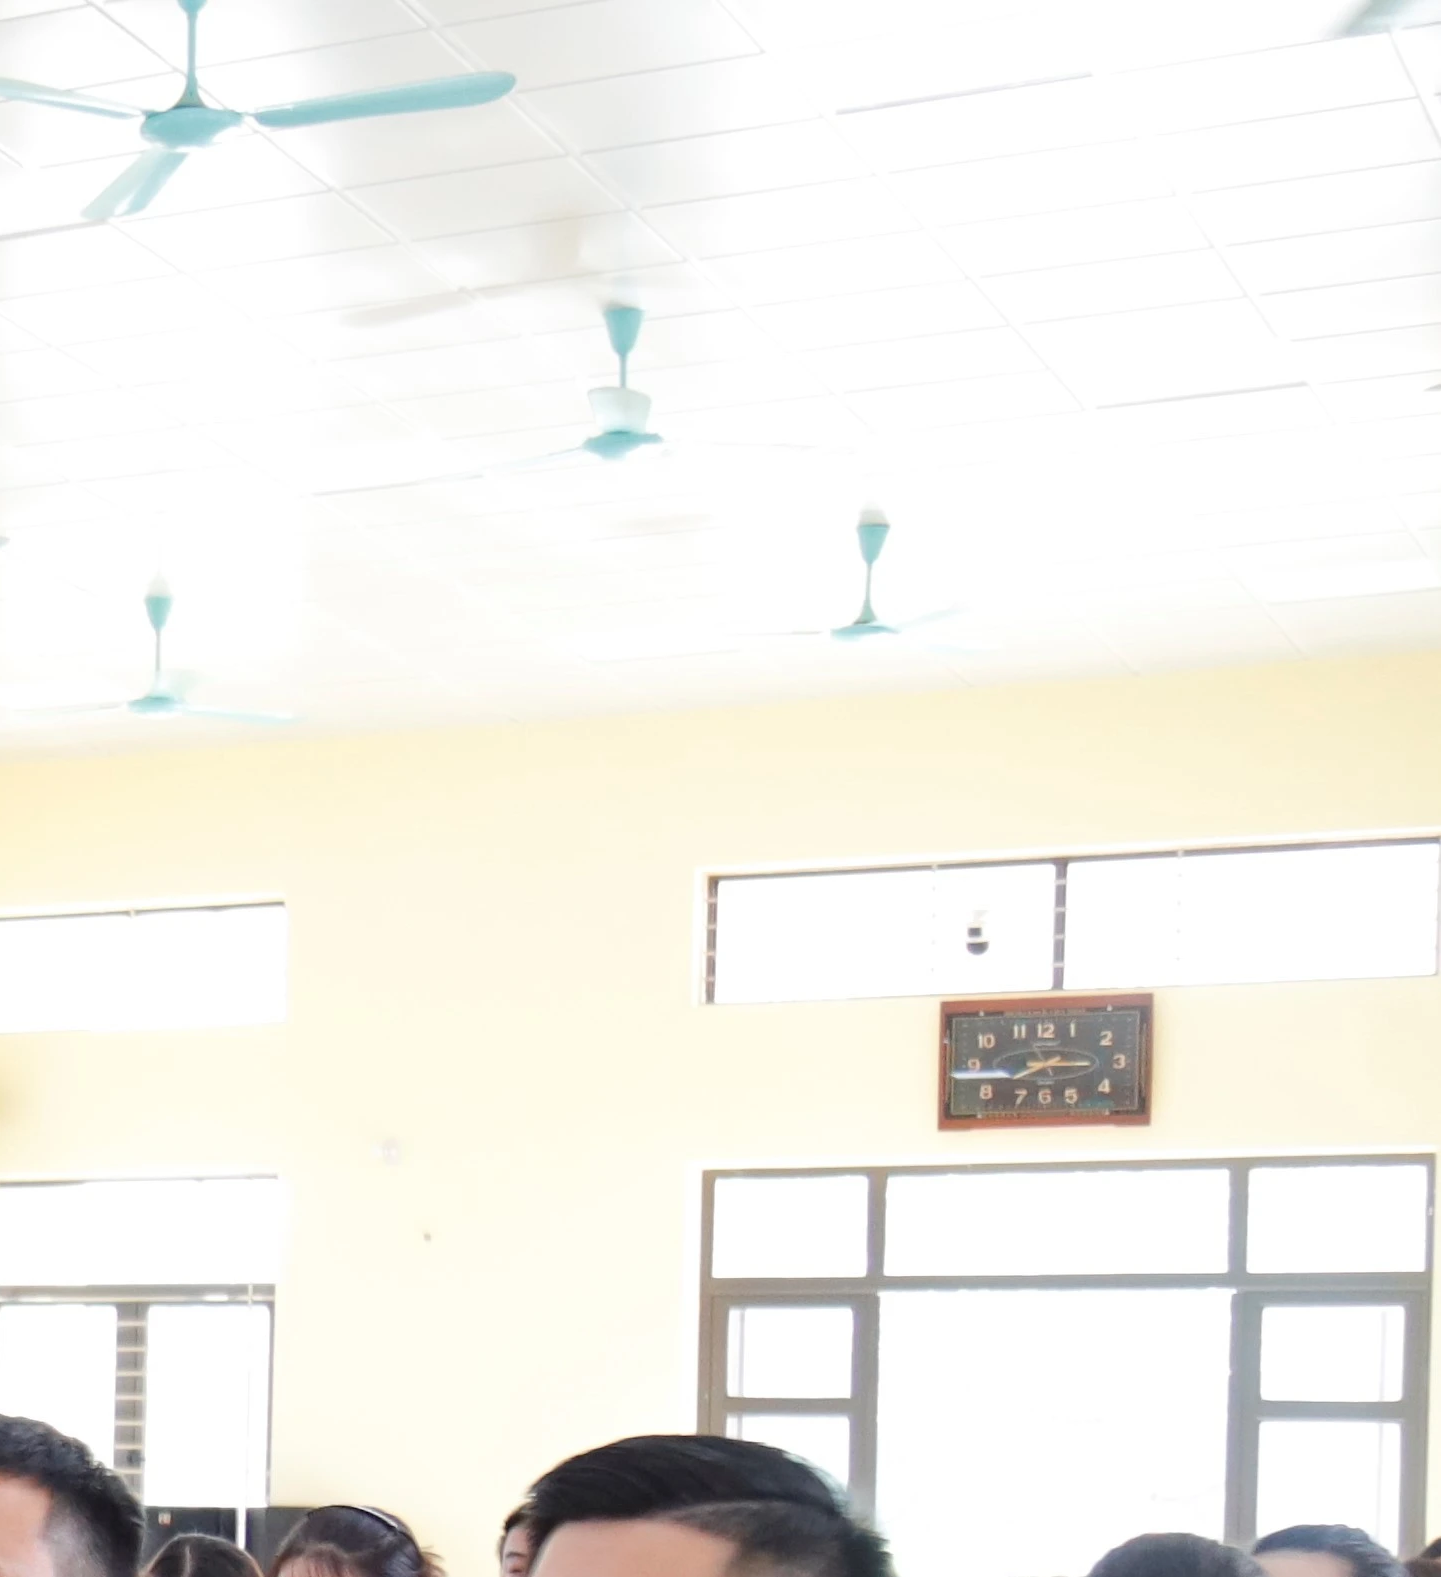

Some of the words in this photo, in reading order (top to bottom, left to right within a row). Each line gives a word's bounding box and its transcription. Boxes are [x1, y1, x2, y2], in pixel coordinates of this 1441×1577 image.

[1012, 1023, 1027, 1039] 11
[1037, 1023, 1056, 1039] 12
[1068, 1022, 1076, 1038] 1
[977, 1033, 996, 1049] 10
[1099, 1030, 1113, 1047] 2
[967, 1058, 981, 1072] 9
[1113, 1054, 1127, 1069] 3
[979, 1084, 993, 1100] 8
[1097, 1077, 1111, 1094] 4
[1014, 1089, 1028, 1106] 7
[1037, 1088, 1052, 1105] 6
[1064, 1087, 1078, 1104] 5
